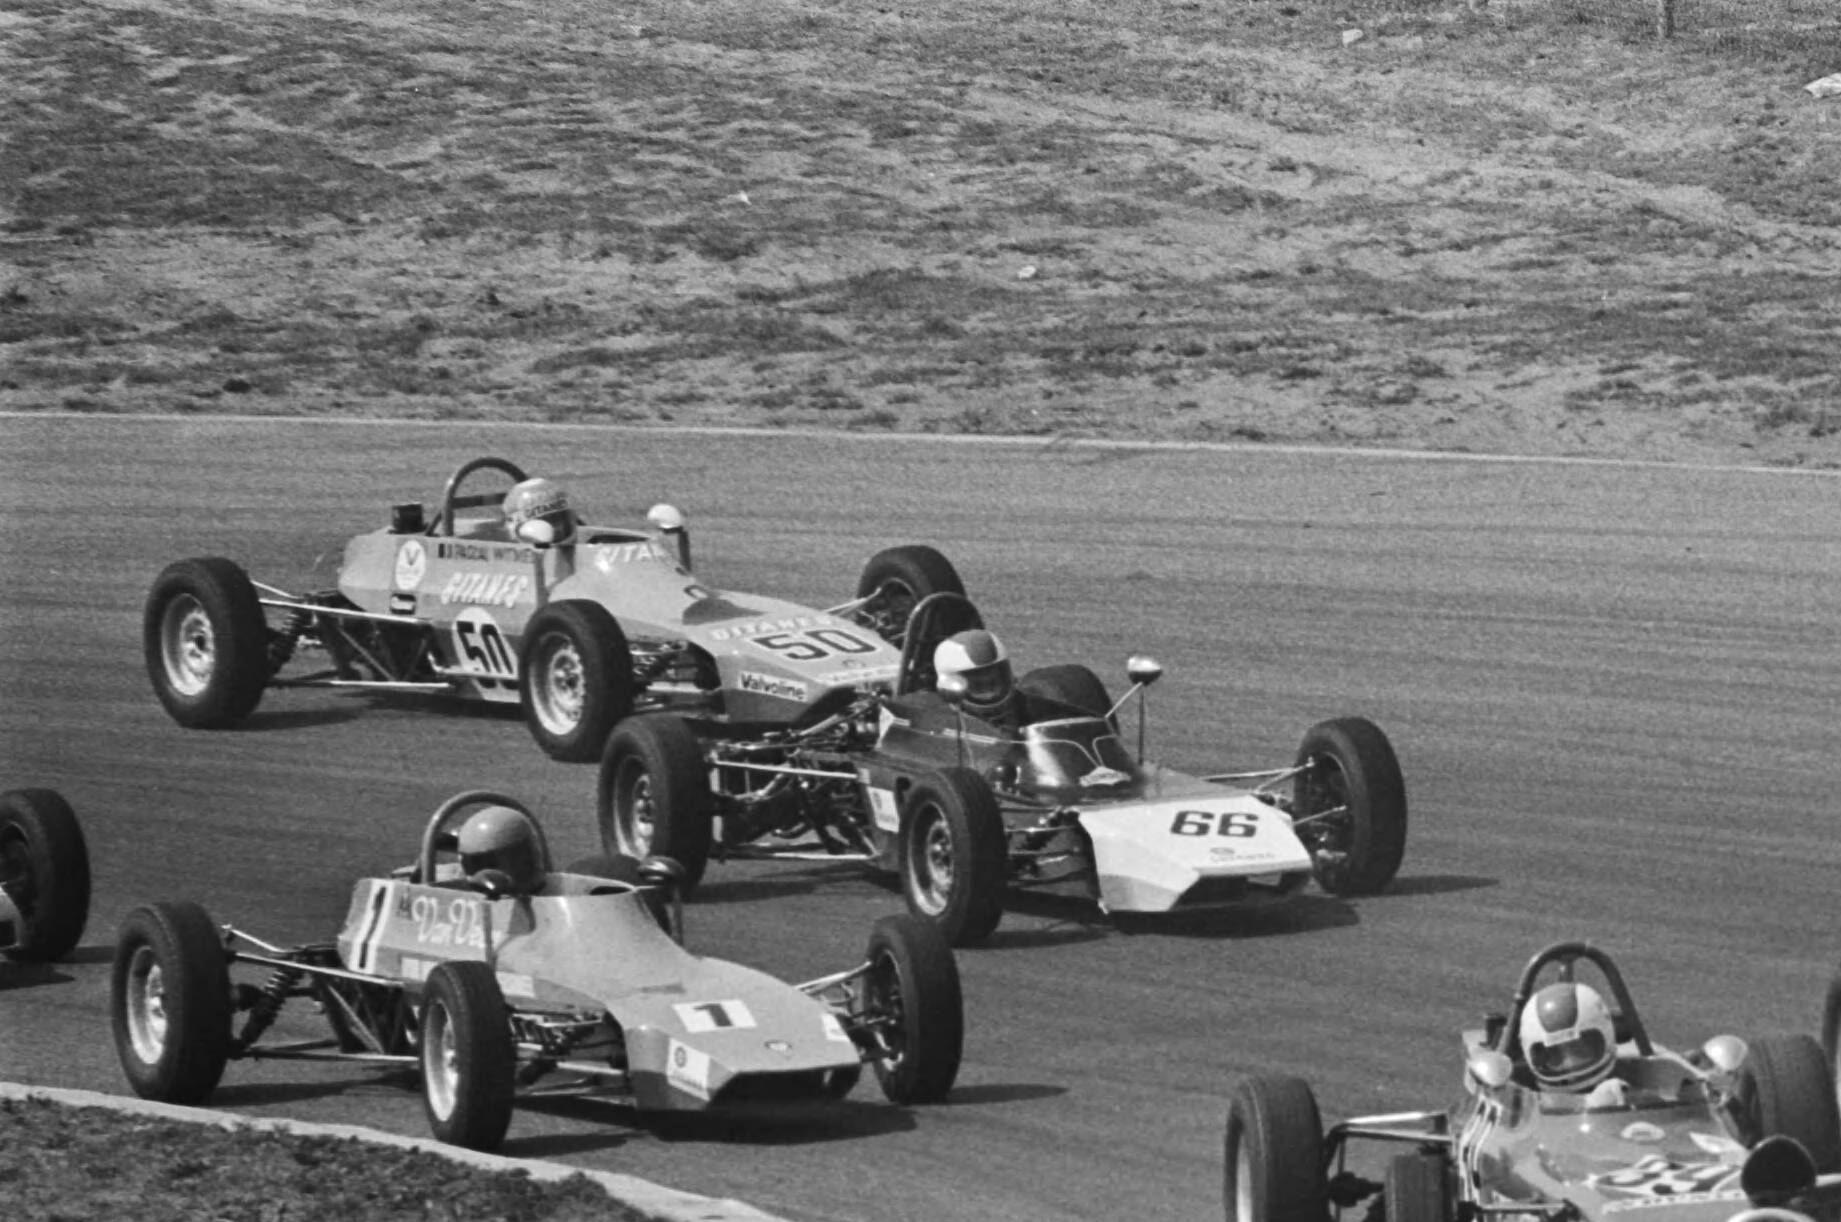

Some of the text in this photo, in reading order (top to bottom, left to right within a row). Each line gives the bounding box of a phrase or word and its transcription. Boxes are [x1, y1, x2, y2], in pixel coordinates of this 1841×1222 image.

[456, 620, 521, 690] 50
[752, 628, 878, 660] 50
[740, 672, 806, 701] Valvoline
[1171, 810, 1259, 838] 66
[693, 1003, 734, 1028] 1
